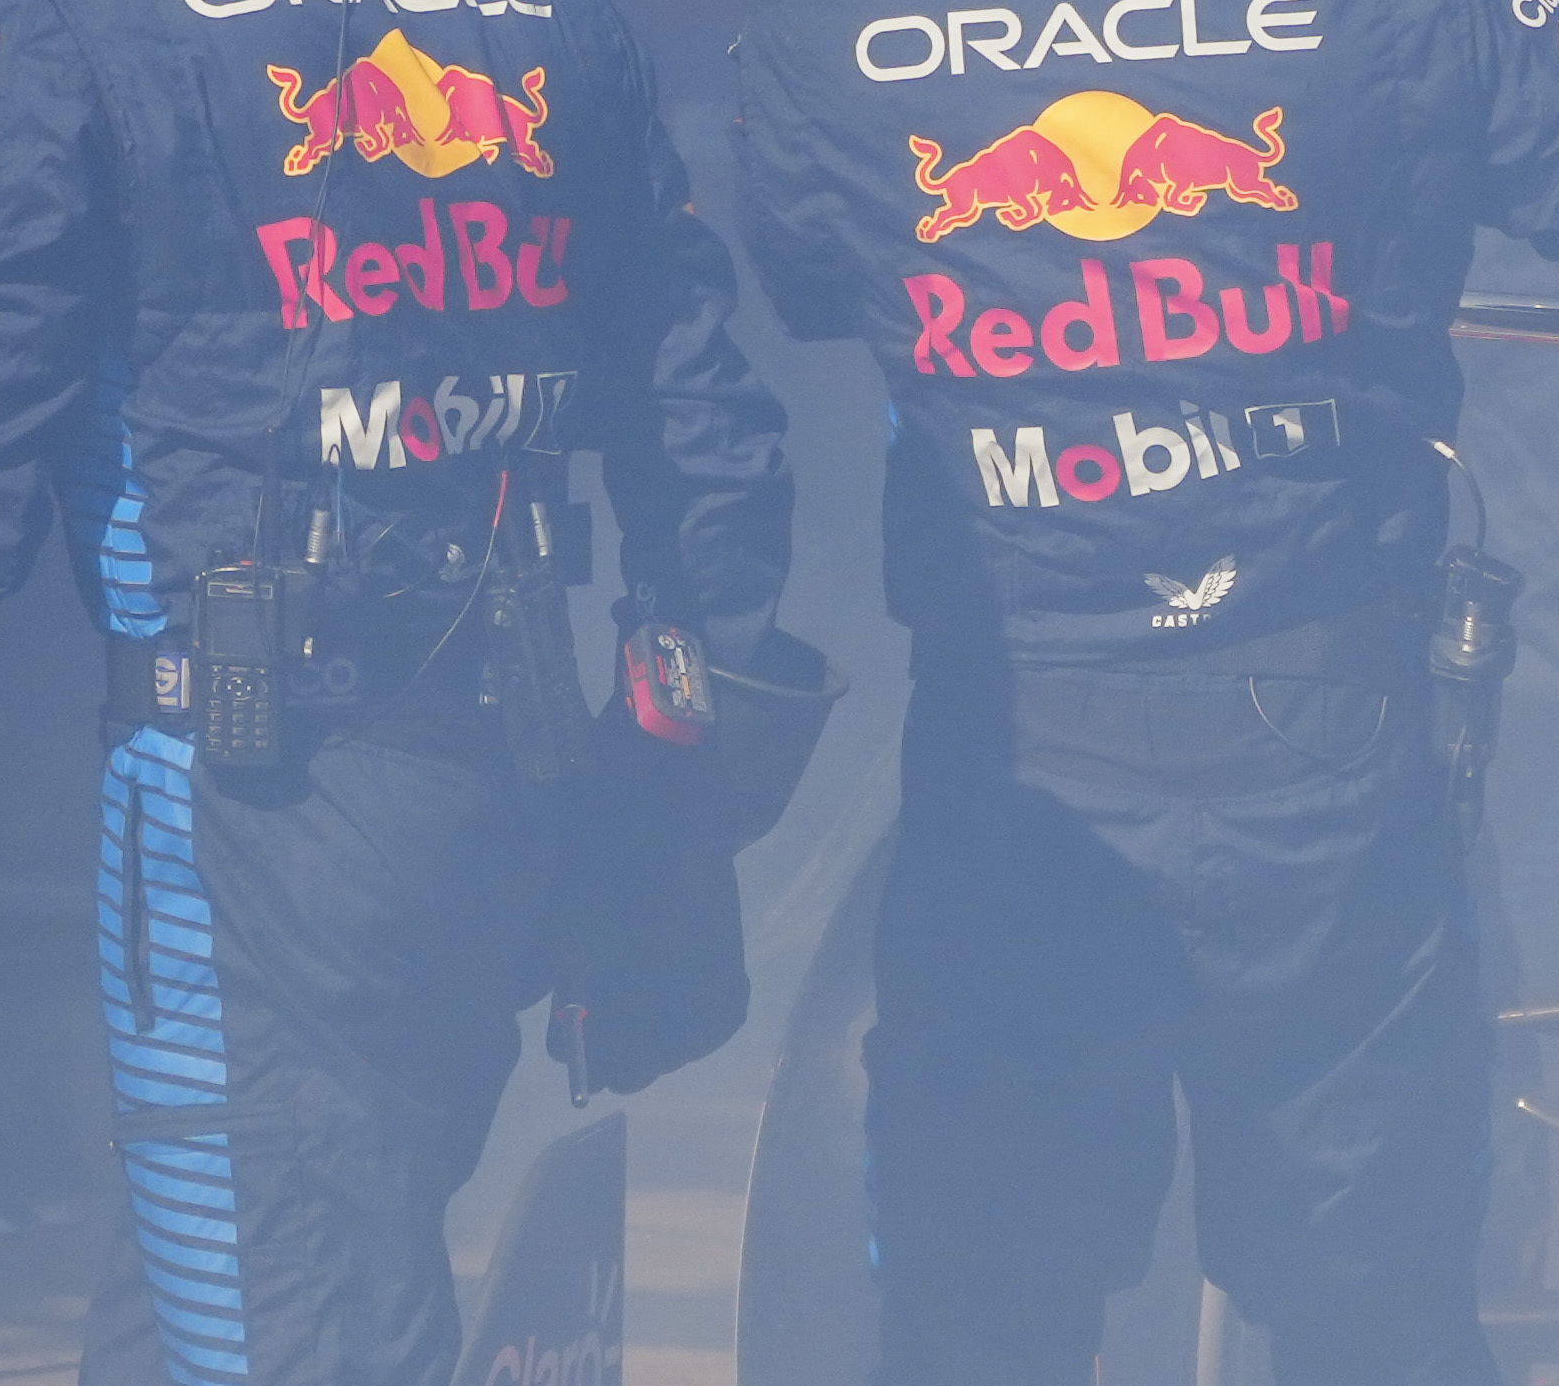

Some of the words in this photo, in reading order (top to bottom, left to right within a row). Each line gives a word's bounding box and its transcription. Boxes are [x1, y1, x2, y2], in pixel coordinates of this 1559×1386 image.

[256, 197, 446, 330] Red
[902, 258, 1122, 378] Red
[1129, 241, 1350, 363] Bull
[320, 373, 526, 471] Mobil
[971, 401, 1242, 509] Mobil
